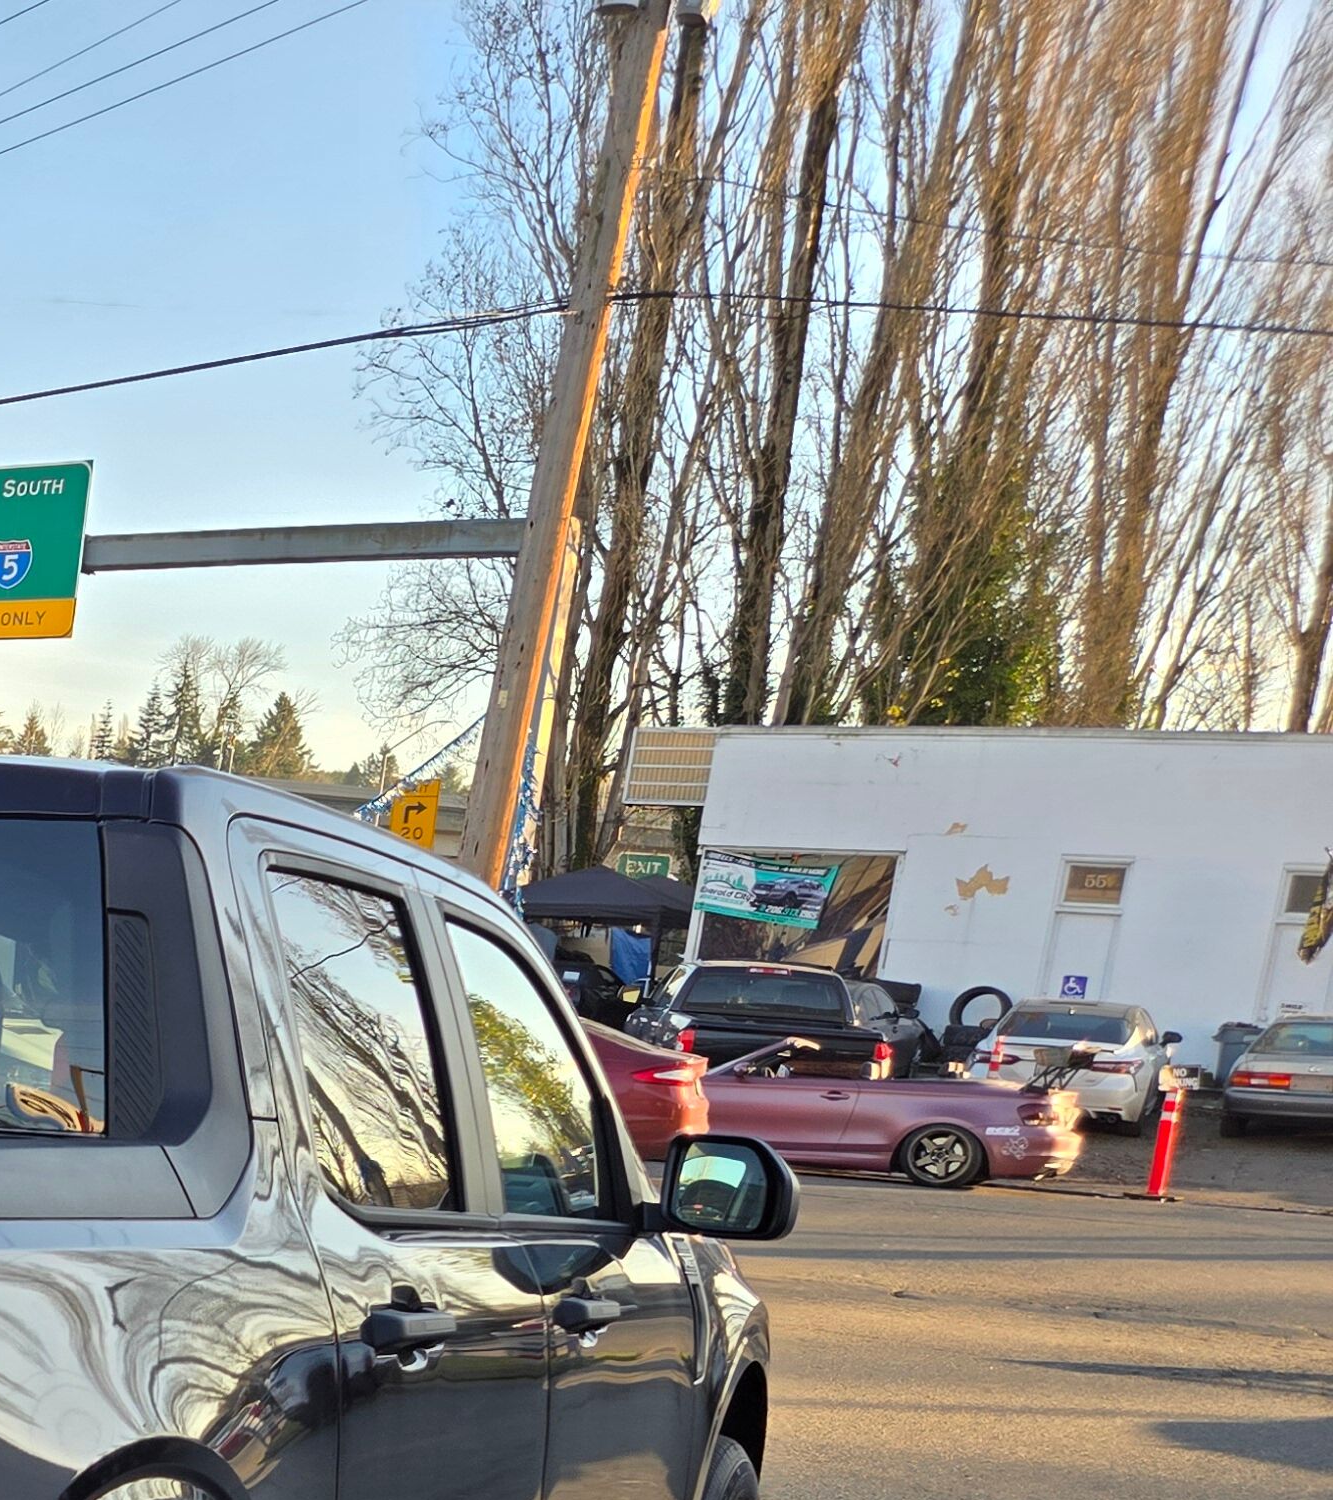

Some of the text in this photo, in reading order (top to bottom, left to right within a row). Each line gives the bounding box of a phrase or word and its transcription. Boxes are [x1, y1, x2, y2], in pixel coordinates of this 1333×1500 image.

[2, 478, 65, 498] SOUTH
[1, 554, 19, 581] 5
[0, 610, 47, 627] ONLY
[400, 826, 424, 840] 20
[625, 859, 662, 875] EXIT
[1172, 1067, 1188, 1078] NO
